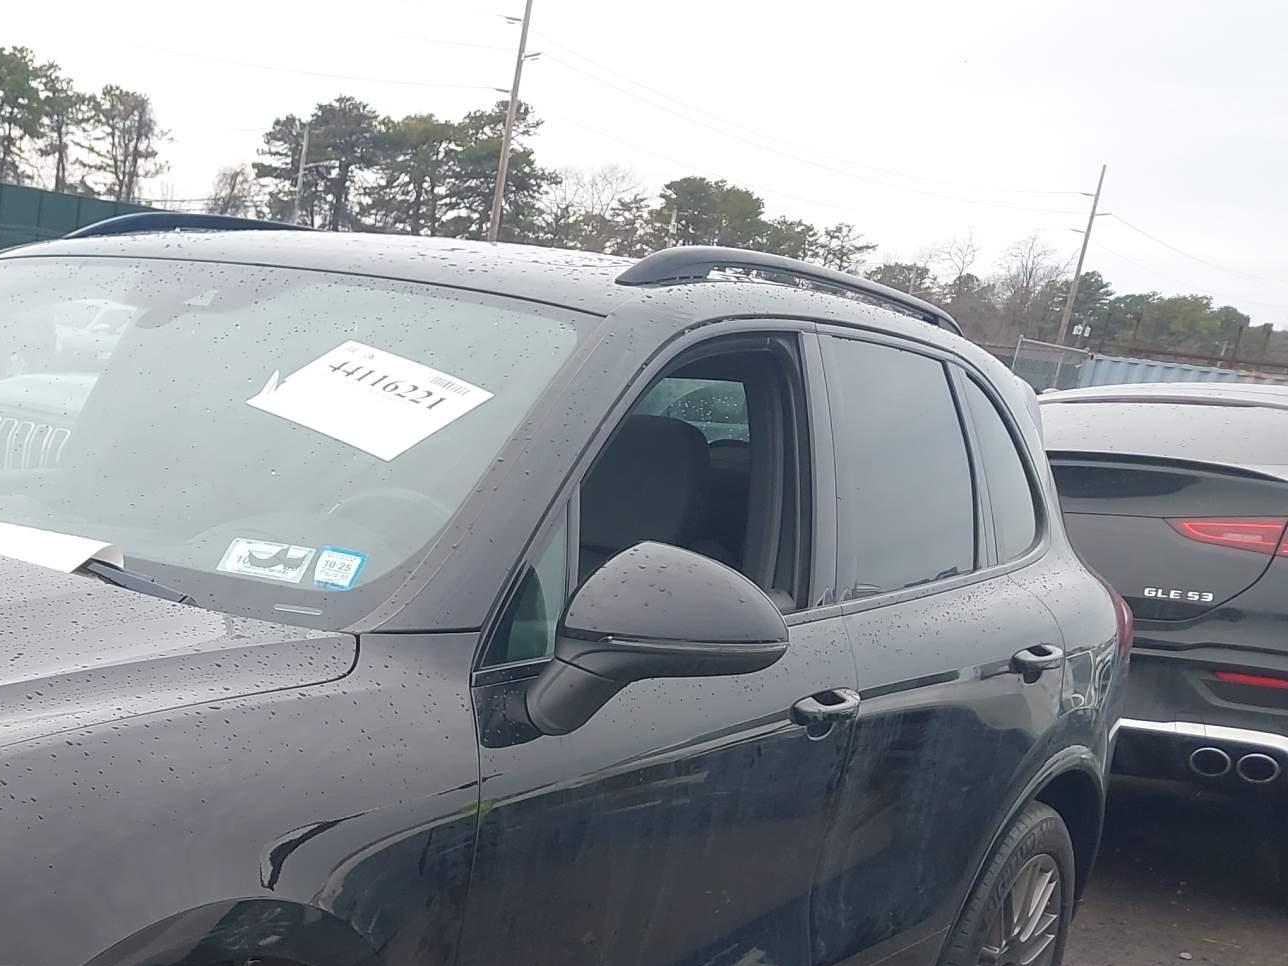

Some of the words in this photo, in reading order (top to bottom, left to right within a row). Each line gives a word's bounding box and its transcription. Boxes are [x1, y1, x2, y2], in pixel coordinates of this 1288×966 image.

[328, 360, 447, 410] 44116221
[1143, 587, 1183, 599] GLE
[1187, 591, 1214, 602] 53
